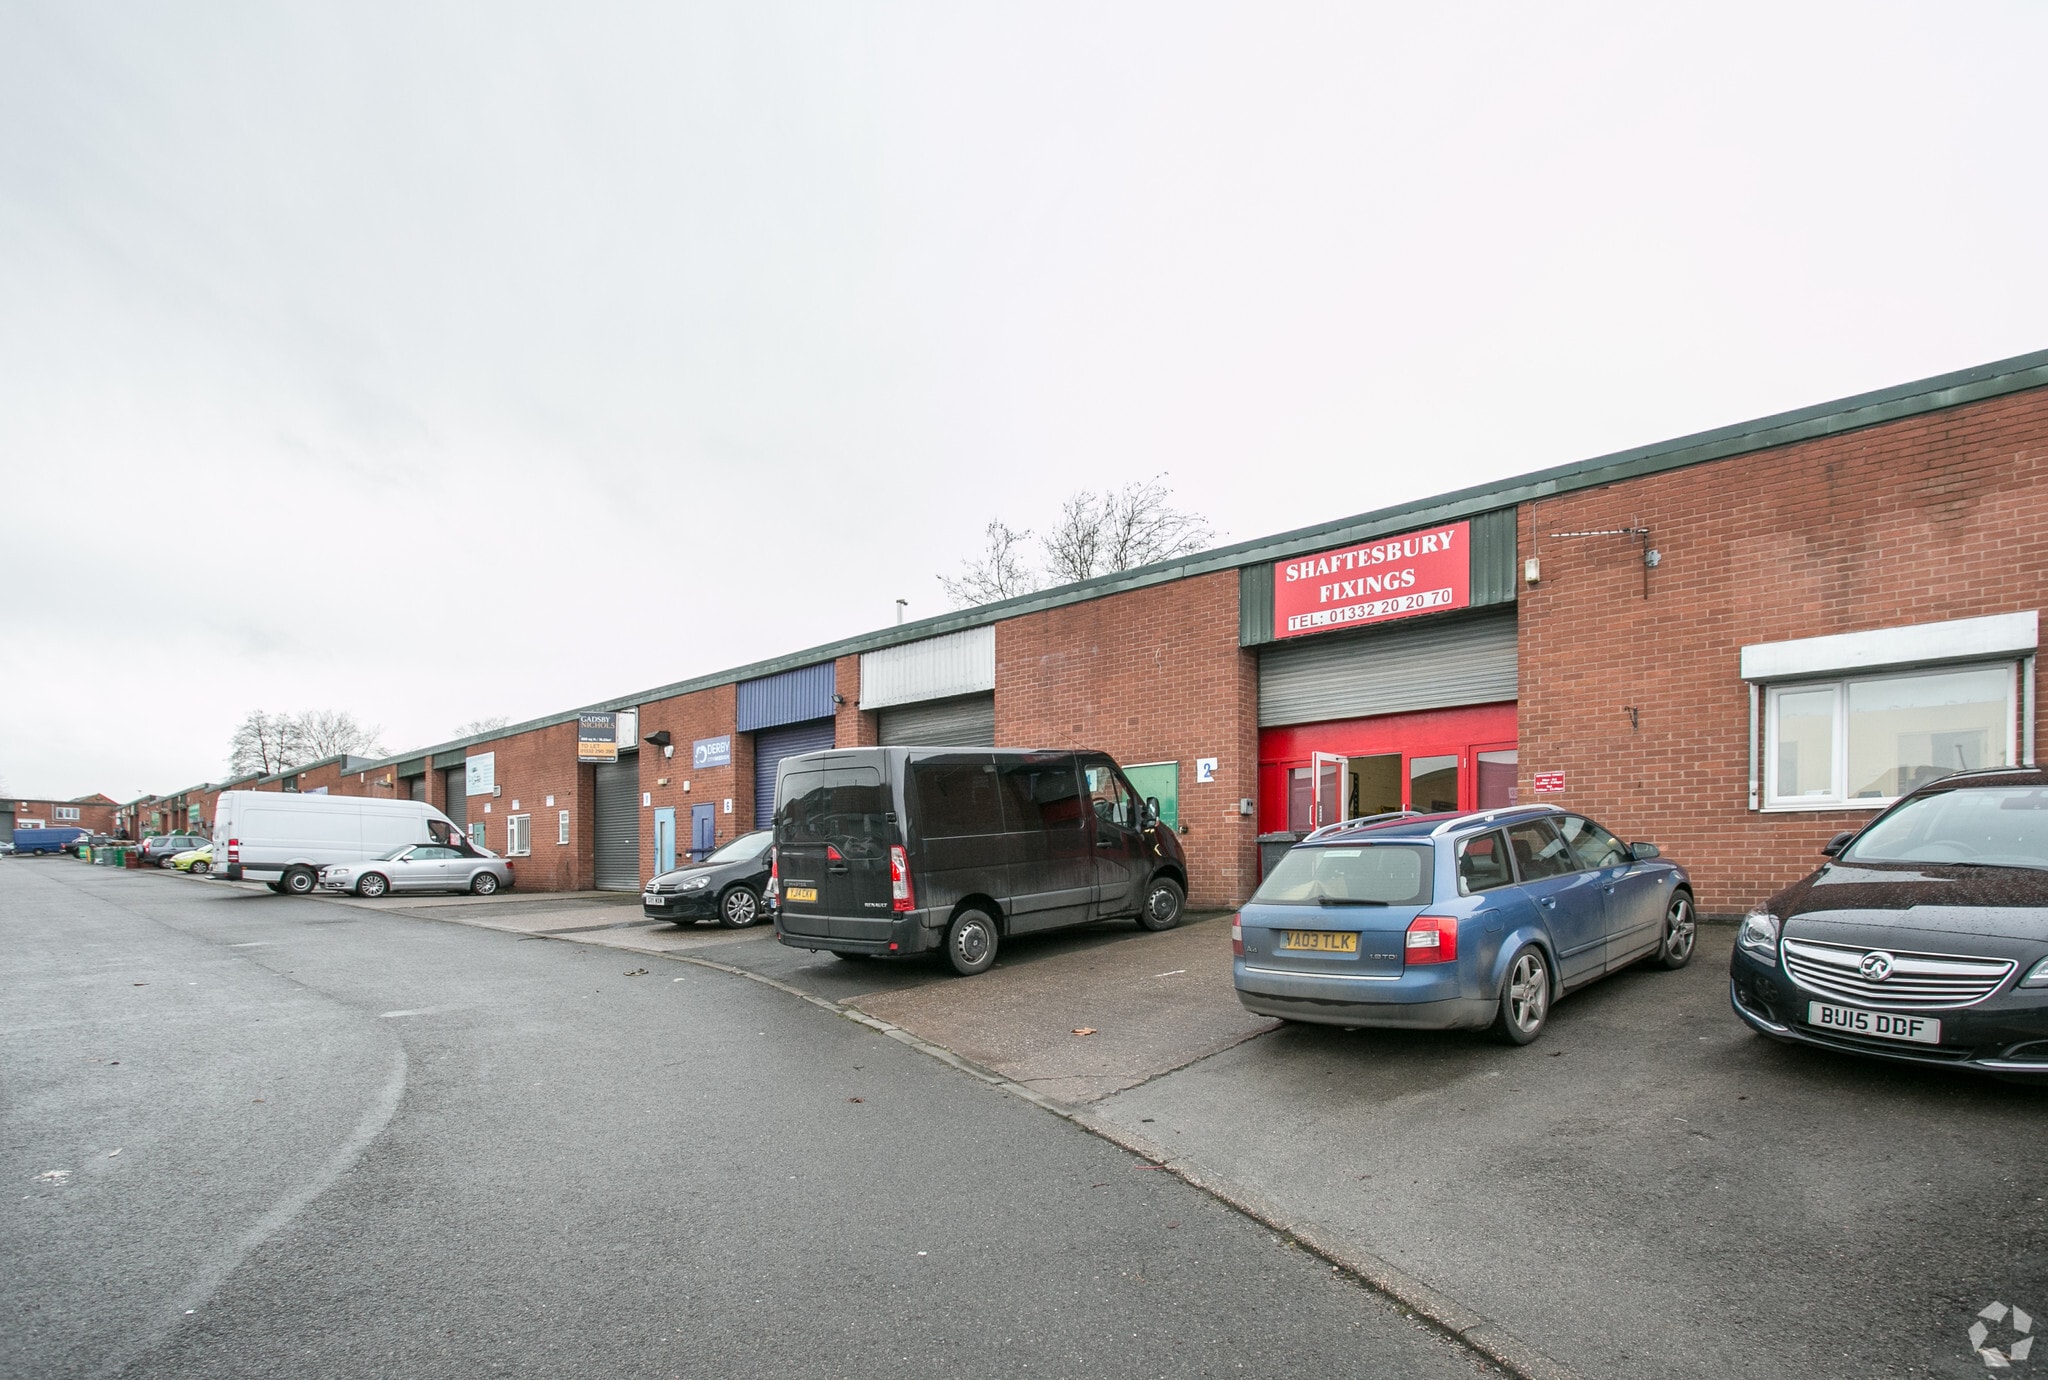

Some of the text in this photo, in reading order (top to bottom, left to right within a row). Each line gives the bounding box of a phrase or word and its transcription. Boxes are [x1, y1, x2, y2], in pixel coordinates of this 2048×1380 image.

[1286, 530, 1455, 582] SHAFTESBURY
[1319, 568, 1416, 603] FIXINGS
[1290, 590, 1450, 630] TEL: 01332 20 20 70
[580, 715, 611, 723] GADSBY
[707, 741, 730, 755] DERBY
[1203, 763, 1212, 778] 2
[1323, 934, 1350, 949] TLK
[1821, 1006, 1924, 1037] BU15 DDF
